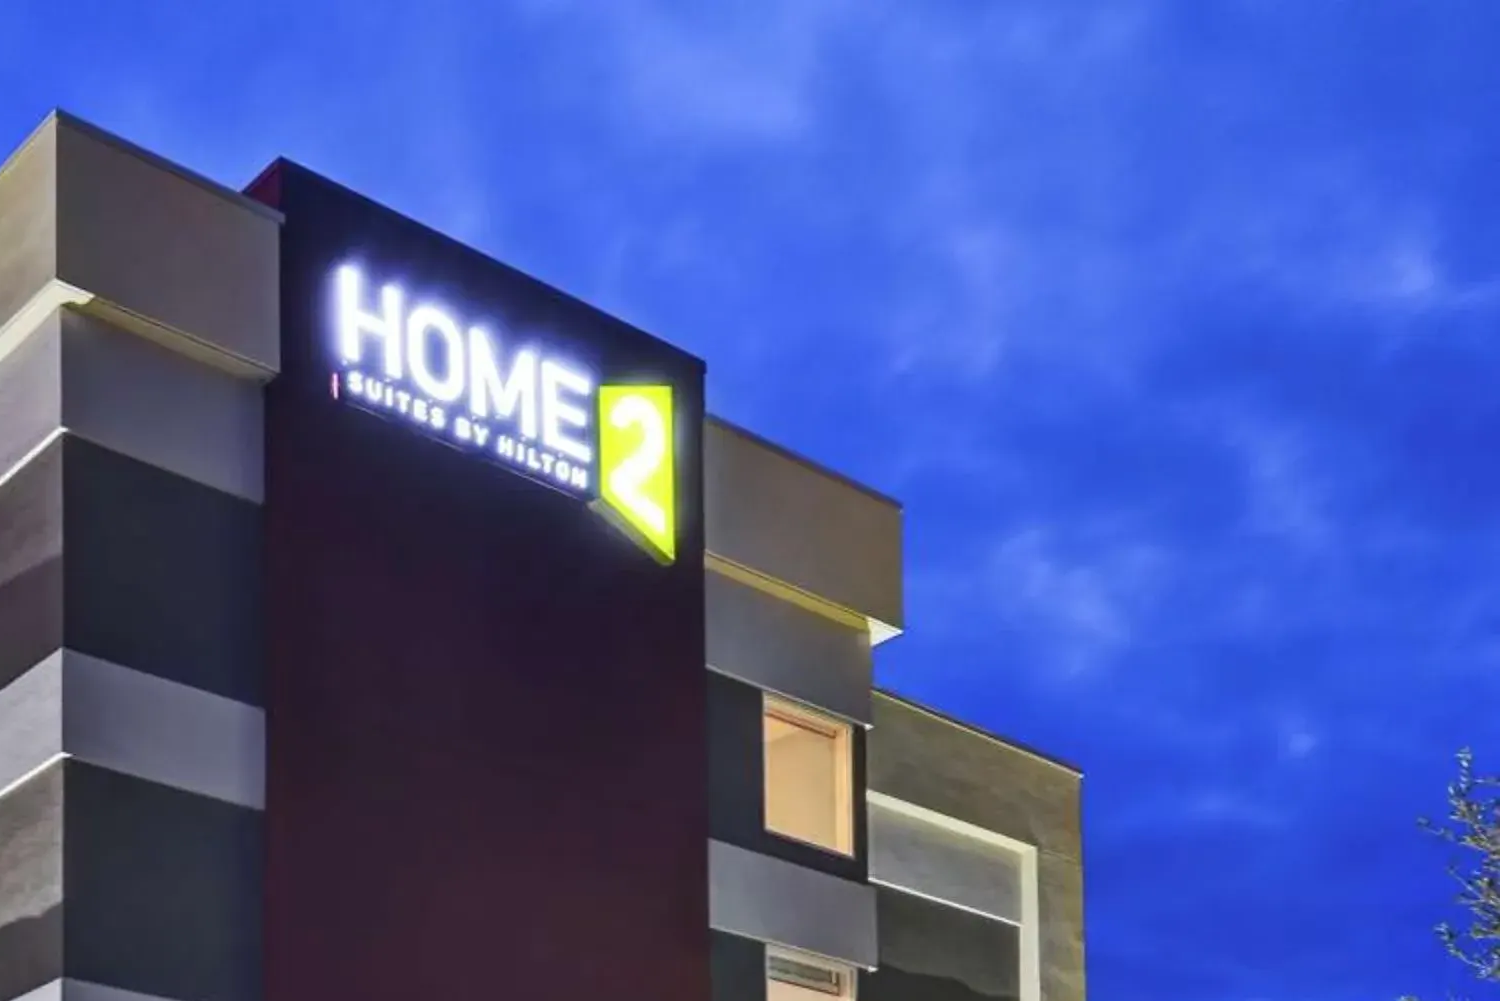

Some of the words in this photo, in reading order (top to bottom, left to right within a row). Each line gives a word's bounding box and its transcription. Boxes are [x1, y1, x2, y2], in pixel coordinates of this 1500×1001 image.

[347, 370, 446, 429] SUITES
[454, 416, 490, 447] BY
[497, 434, 588, 489] HILTON
